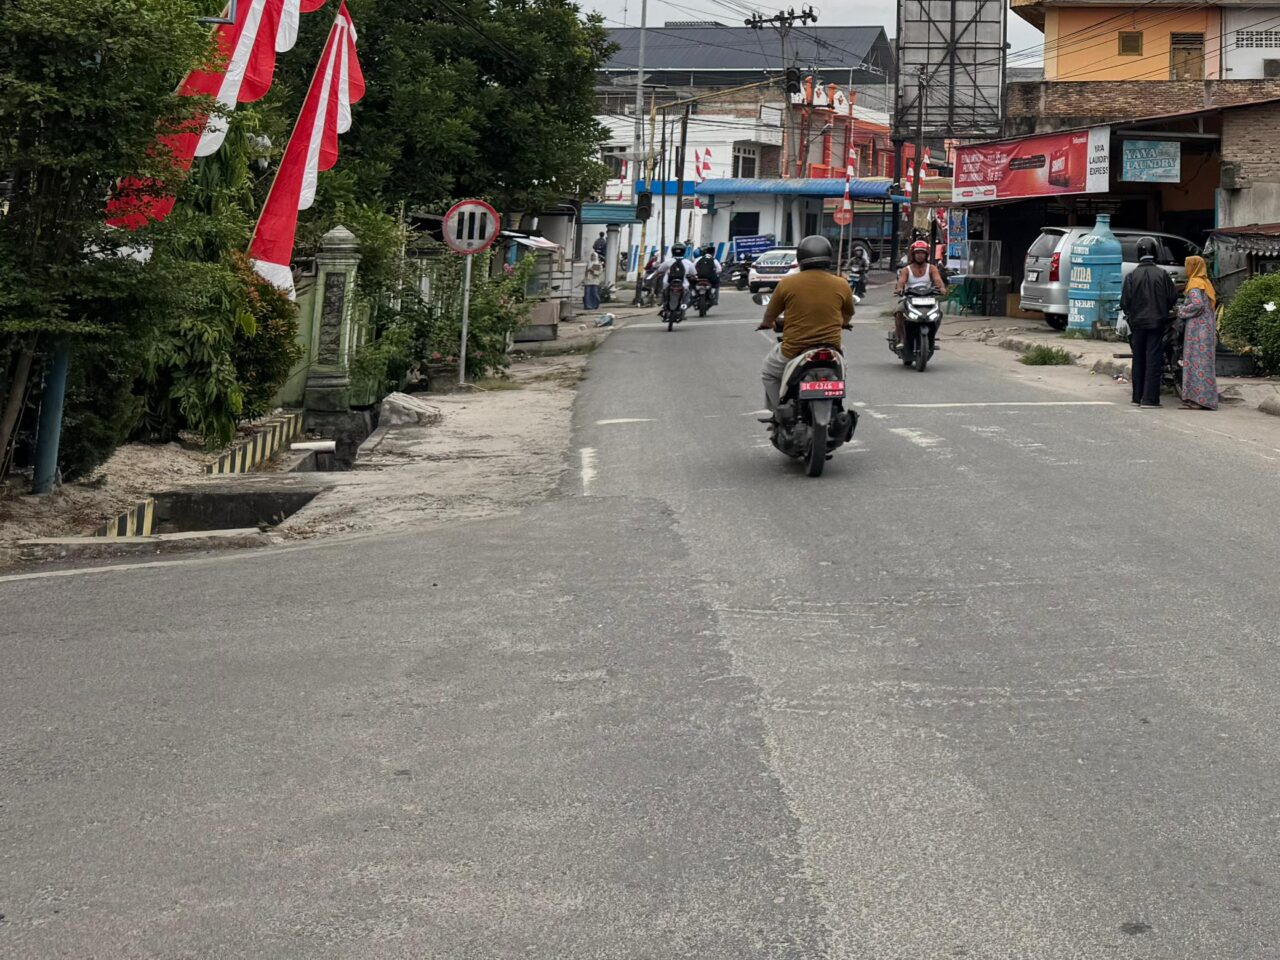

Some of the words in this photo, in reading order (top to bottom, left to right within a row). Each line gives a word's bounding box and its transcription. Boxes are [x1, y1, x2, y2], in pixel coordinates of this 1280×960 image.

[1126, 148, 1157, 159] YAYA
[1126, 158, 1177, 170] LAUNDRY
[1089, 166, 1109, 176] EXPRESS
